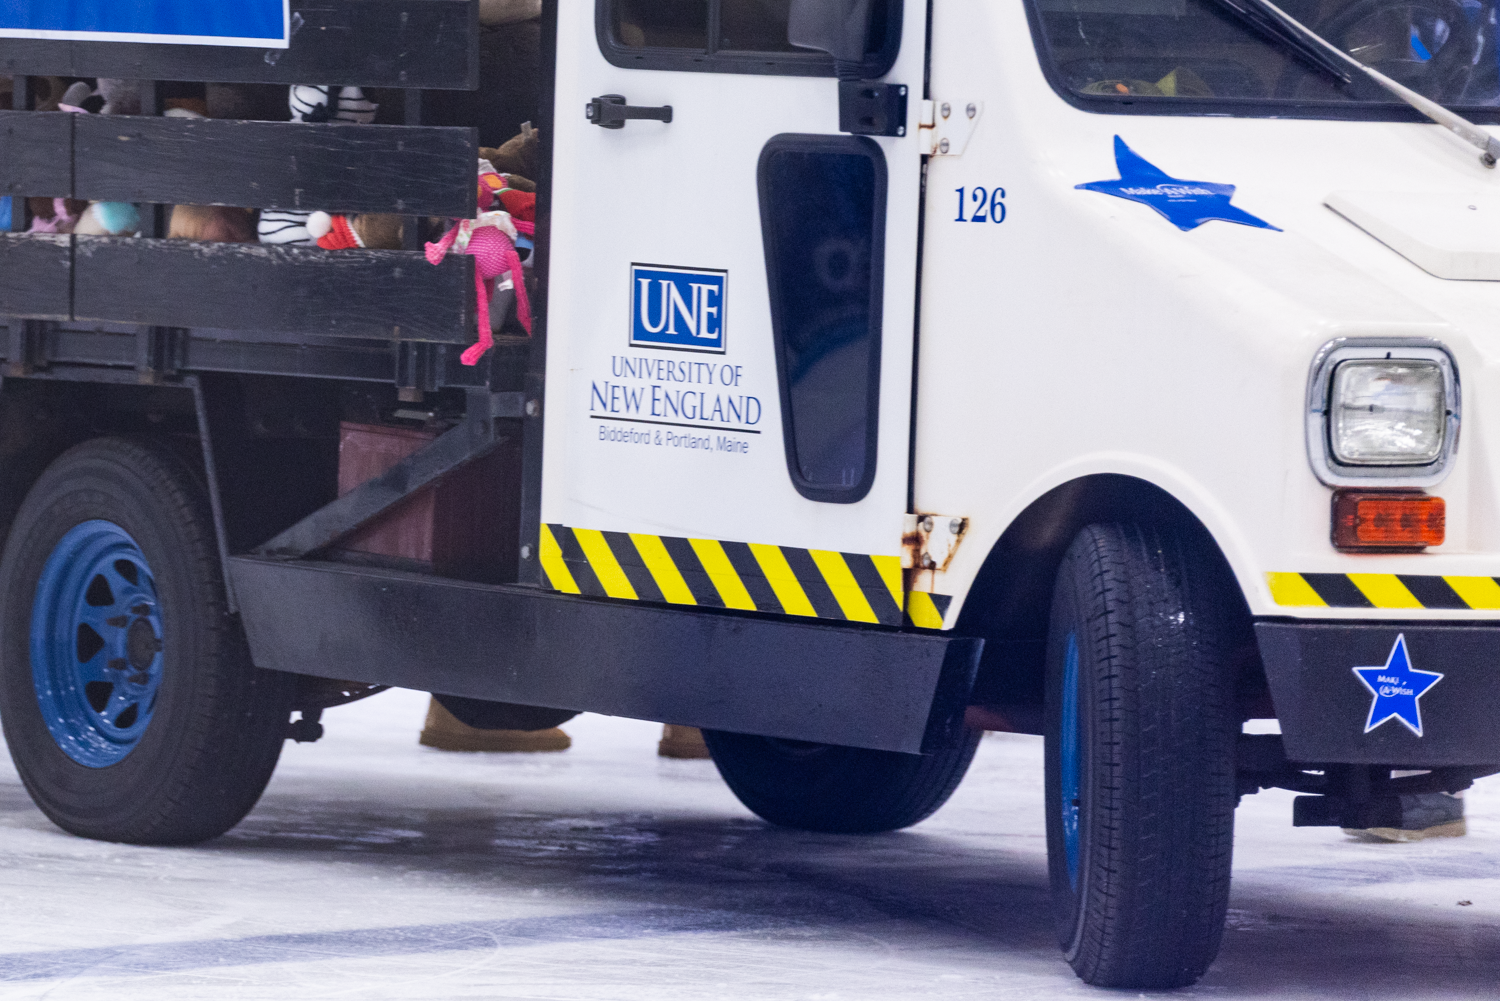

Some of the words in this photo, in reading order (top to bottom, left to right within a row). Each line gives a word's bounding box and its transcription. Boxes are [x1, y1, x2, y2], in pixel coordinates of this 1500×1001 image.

[954, 186, 1006, 224] 126
[637, 277, 719, 340] UNE
[611, 355, 717, 386] UNIVERSITY
[720, 364, 743, 387] OF
[589, 380, 645, 415] NEW
[650, 384, 762, 426] ENGLAND
[599, 425, 651, 446] Biddeford
[653, 430, 663, 446] &
[666, 431, 713, 453] Portland,
[716, 436, 749, 454] Maine
